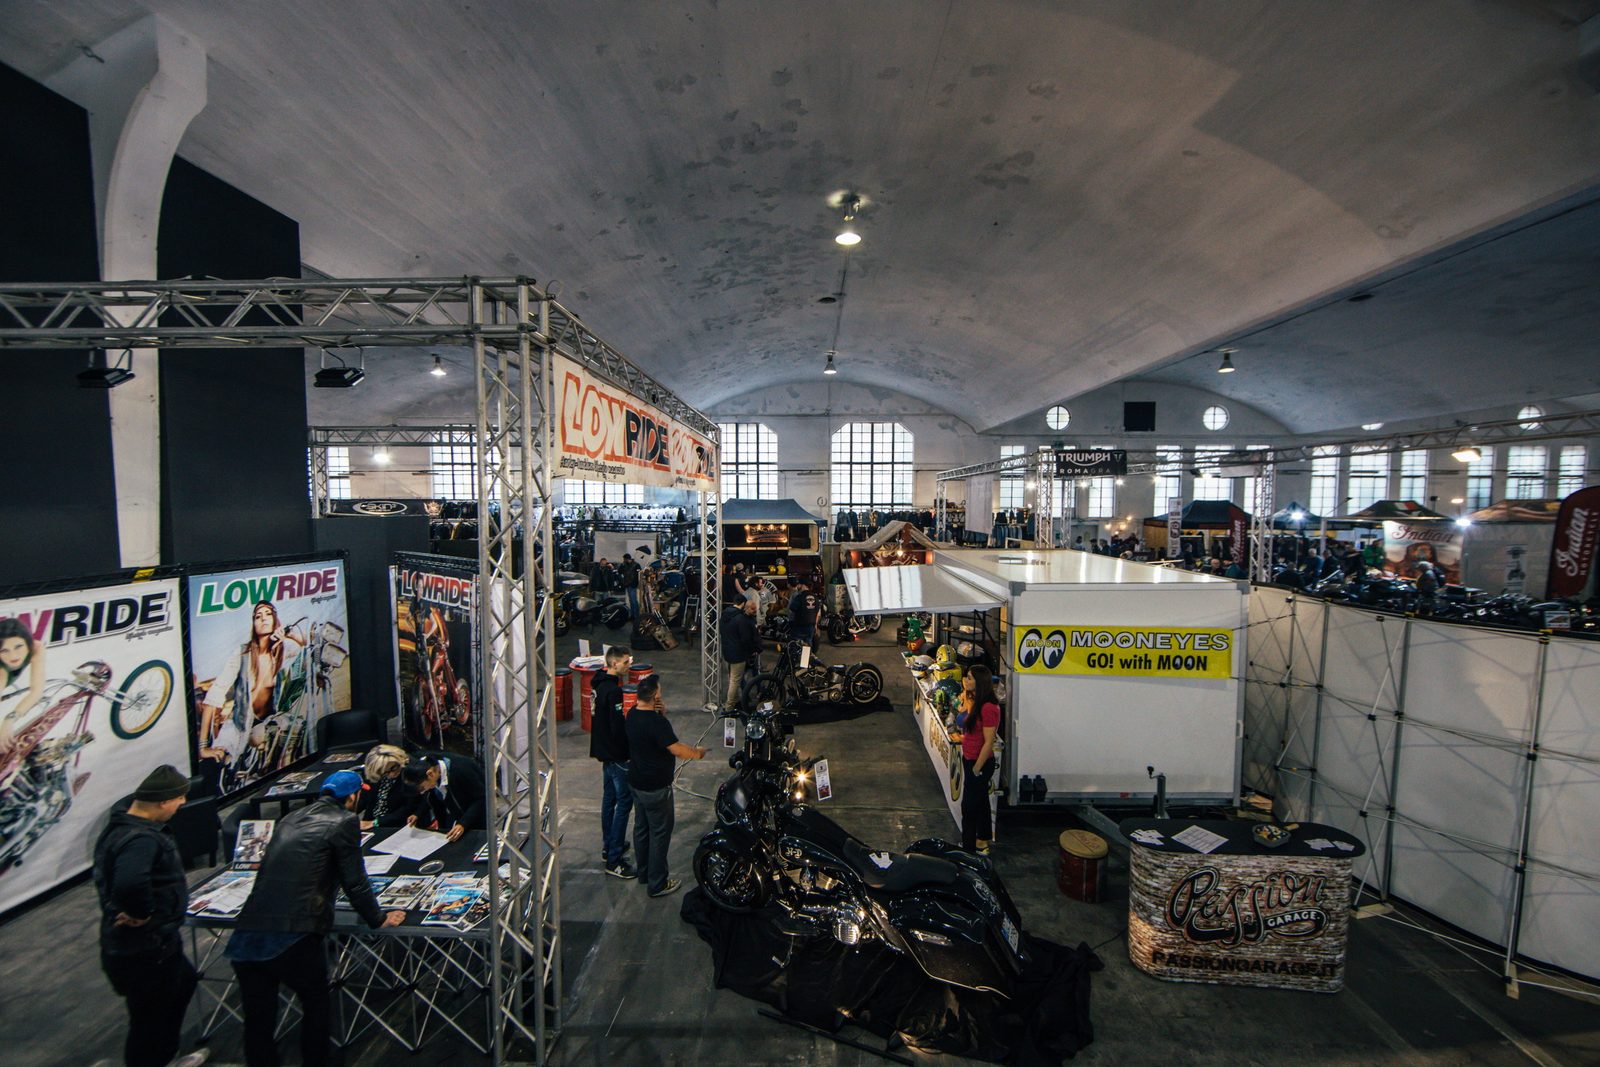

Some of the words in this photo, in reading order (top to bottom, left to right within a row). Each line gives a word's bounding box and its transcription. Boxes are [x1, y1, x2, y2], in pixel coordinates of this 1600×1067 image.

[561, 371, 671, 472] LOWRIDE
[1058, 452, 1110, 464] TRIUMPH
[1392, 524, 1454, 542] Indian
[1555, 507, 1589, 577] Indian
[199, 568, 338, 614] LOWRIDE
[0, 591, 169, 643] WRIDE
[1025, 638, 1061, 648] MOON
[1070, 630, 1229, 651] MOONEYES
[1086, 652, 1114, 669] GO!
[1119, 653, 1152, 670] with
[1157, 654, 1208, 671] MOON
[1166, 867, 1328, 947] Passion
